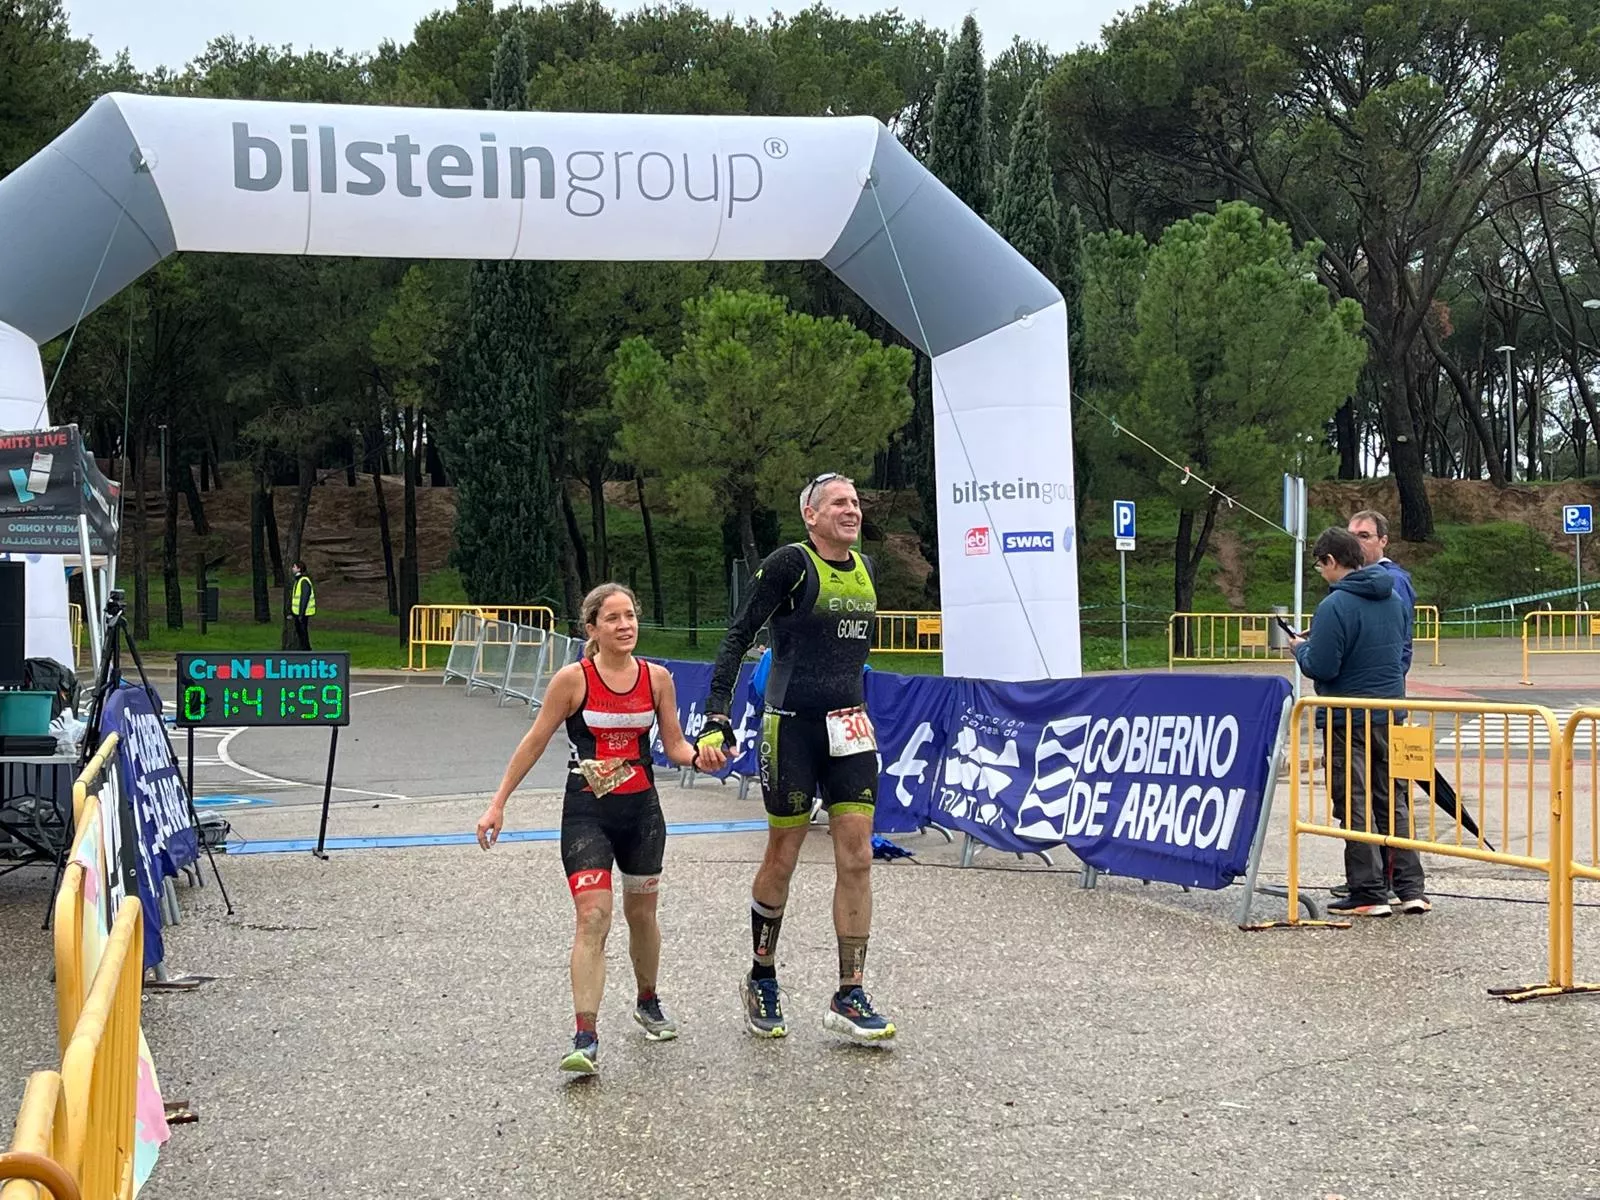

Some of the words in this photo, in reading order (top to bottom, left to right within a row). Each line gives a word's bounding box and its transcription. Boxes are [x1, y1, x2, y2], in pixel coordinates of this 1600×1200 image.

[0, 436, 31, 449] MITS
[35, 432, 67, 447] LIVE
[952, 477, 1074, 504] bilsteingrou
[1119, 506, 1131, 534] P
[1566, 508, 1579, 526] P
[1006, 535, 1051, 549] SWAG
[837, 619, 869, 639] GOMEZ
[608, 740, 629, 751] ESP
[1083, 714, 1239, 779] GOBIERNO
[1066, 781, 1112, 837] DE
